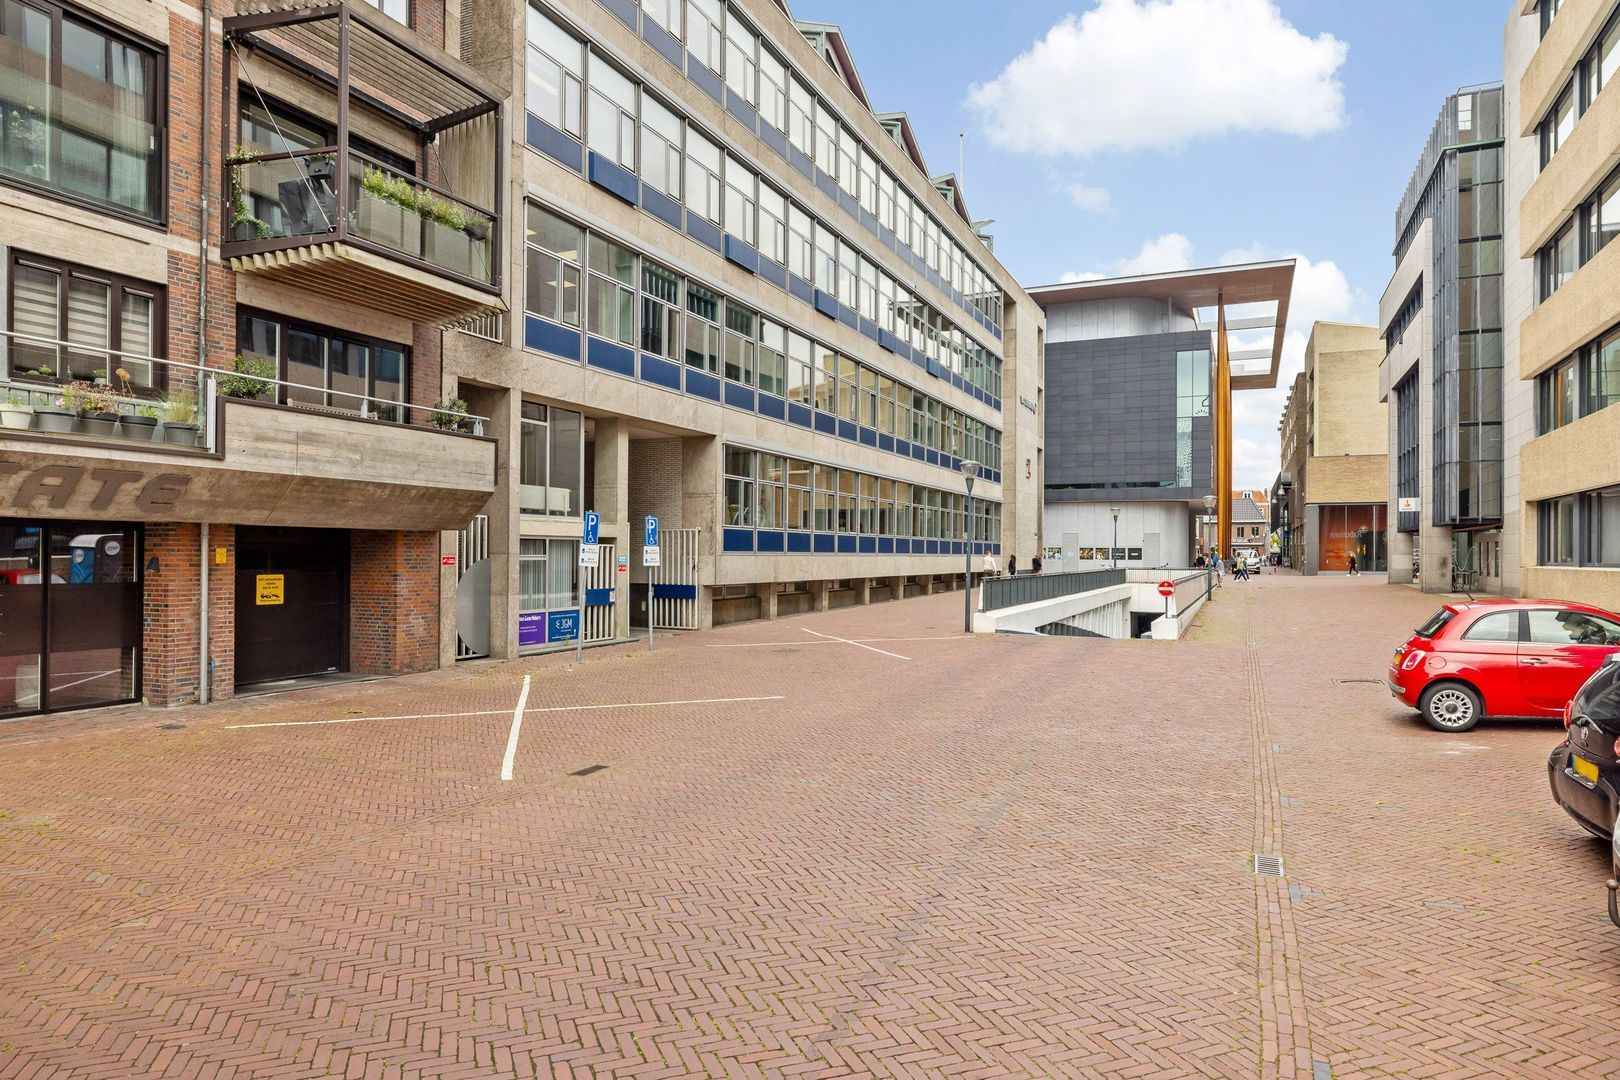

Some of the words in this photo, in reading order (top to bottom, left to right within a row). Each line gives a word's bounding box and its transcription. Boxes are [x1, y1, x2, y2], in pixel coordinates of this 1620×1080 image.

[0, 462, 192, 514] ATE
[588, 515, 597, 530] P
[648, 520, 656, 534] P
